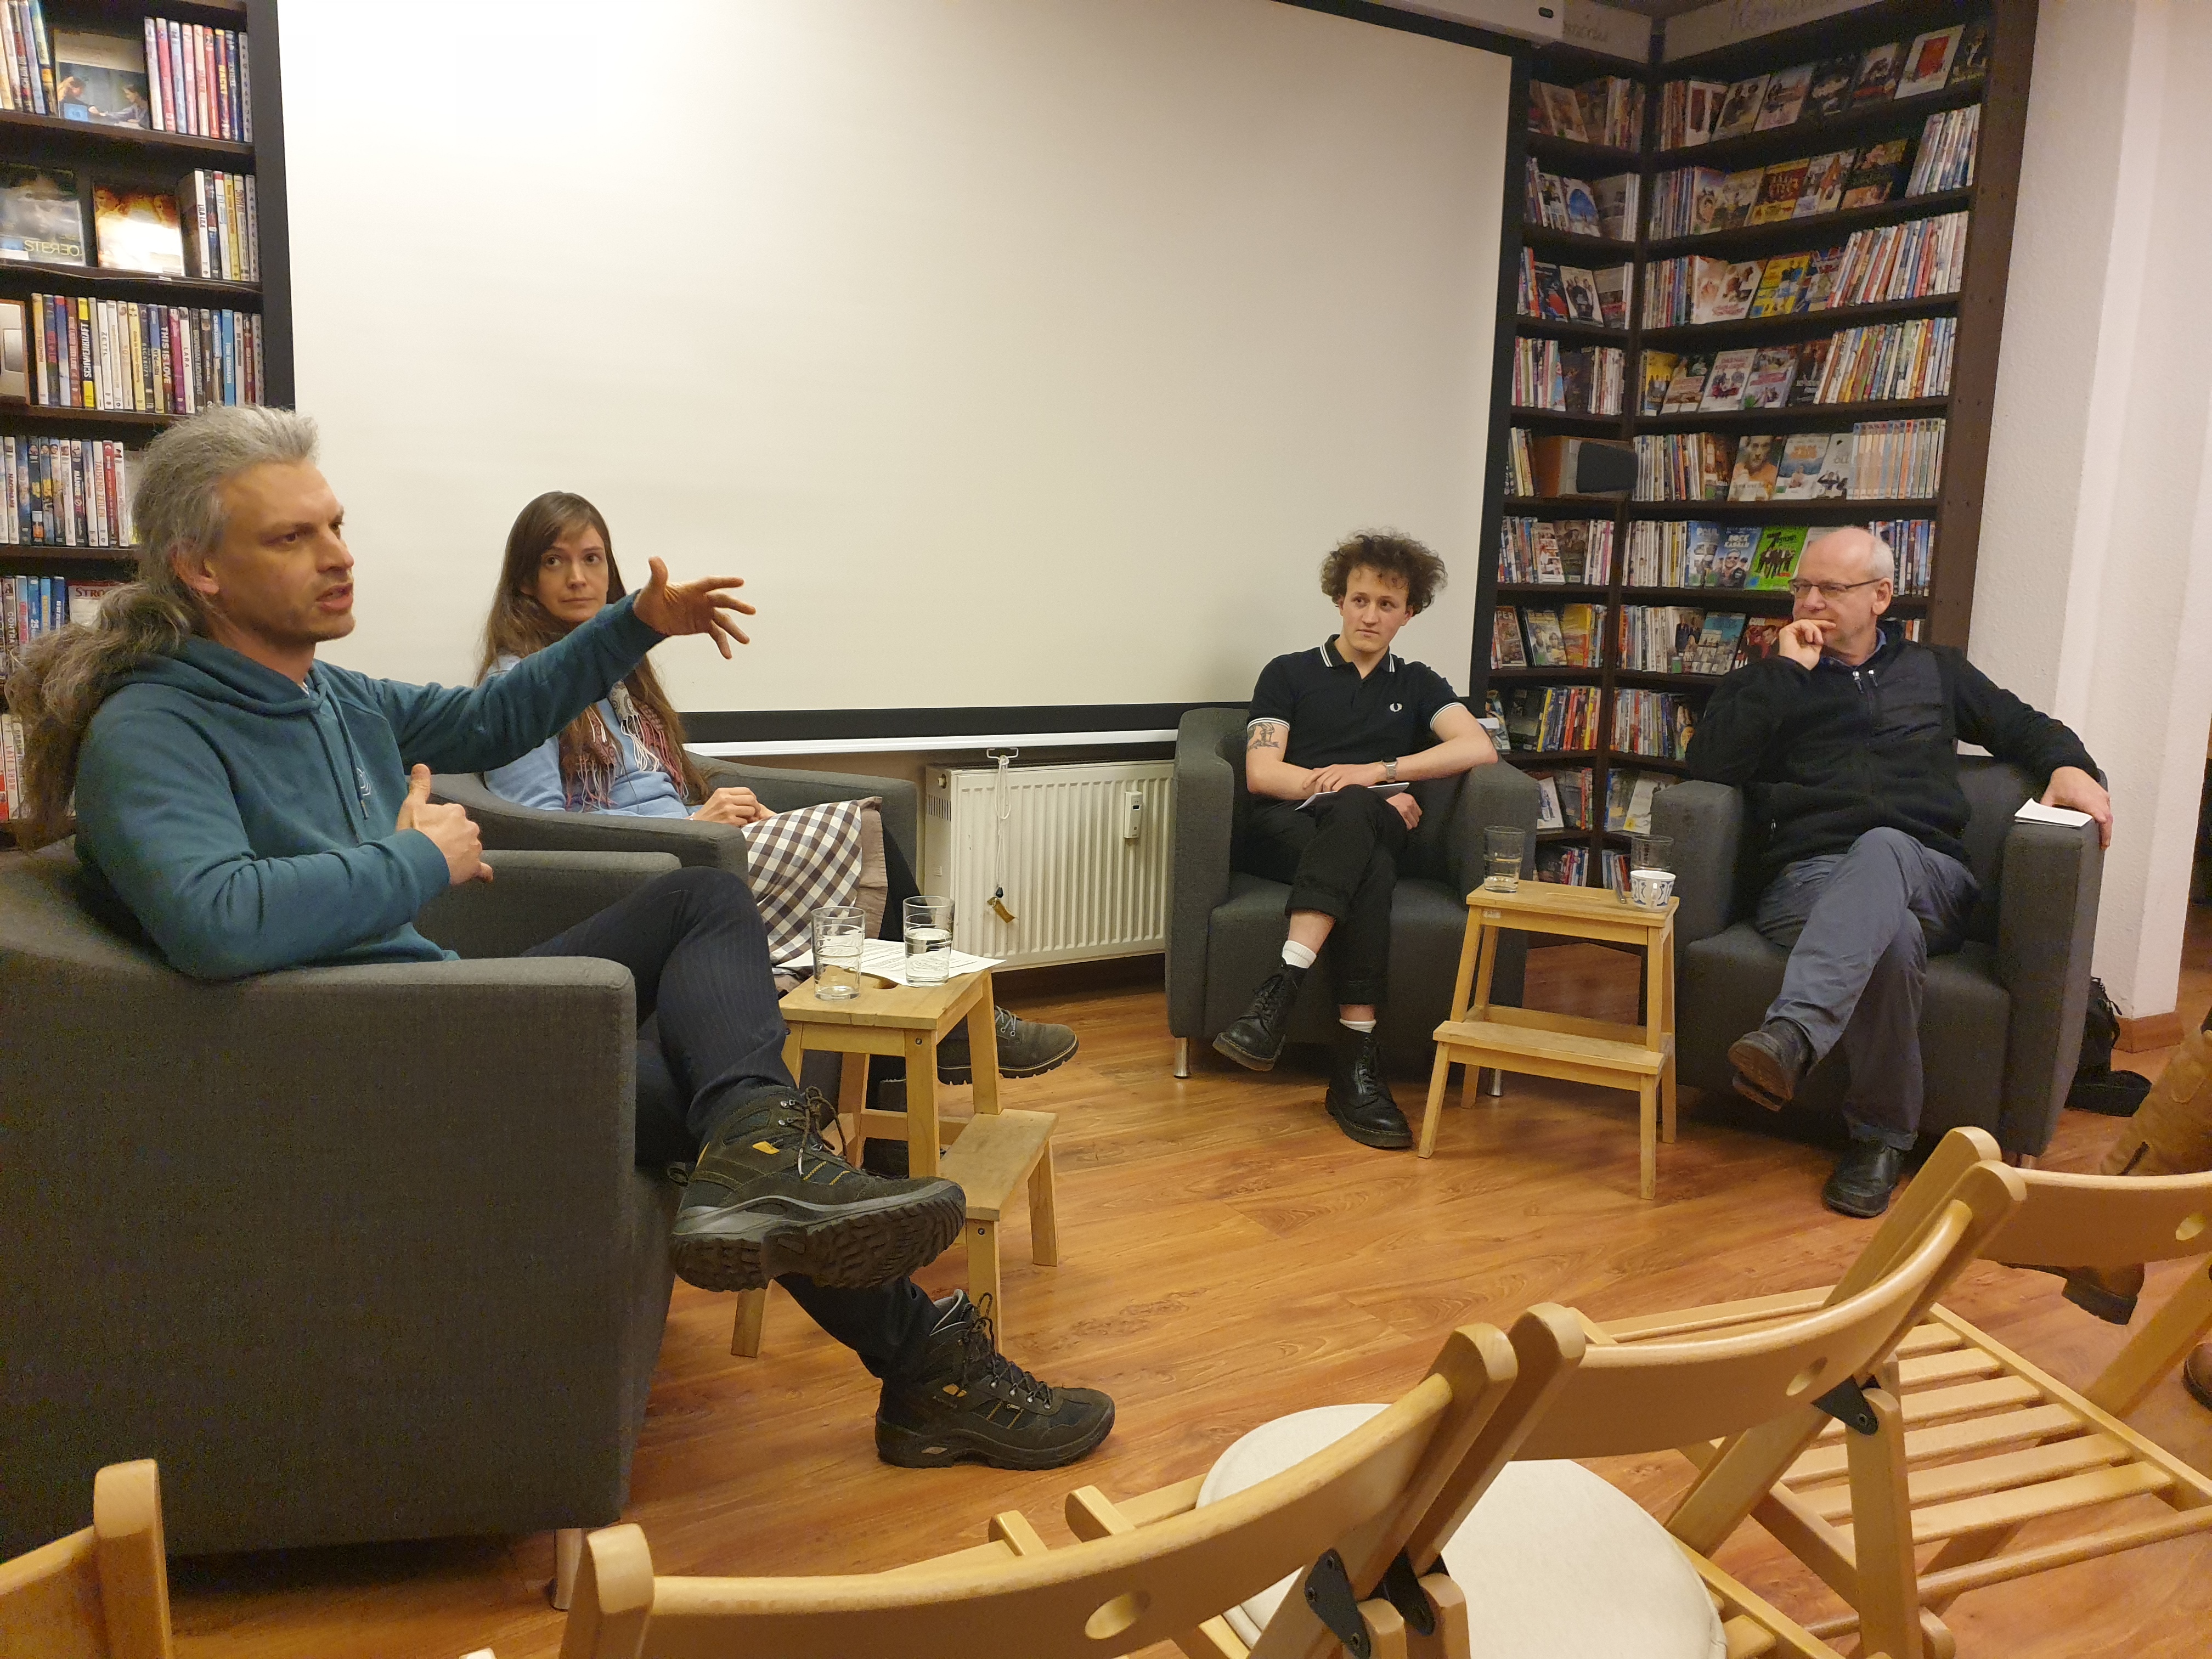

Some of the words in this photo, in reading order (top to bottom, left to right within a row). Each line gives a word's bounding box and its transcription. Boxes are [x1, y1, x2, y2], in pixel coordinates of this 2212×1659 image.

[161, 326, 170, 348] THIS
[80, 322, 92, 378] SCHWERKRAFT
[162, 351, 170, 359] IS
[163, 362, 171, 384] LOVE
[94, 460, 104, 492] TAUSEND
[98, 494, 106, 517] ZEILEN
[75, 586, 105, 597] STRO
[1497, 610, 1514, 620] PER
